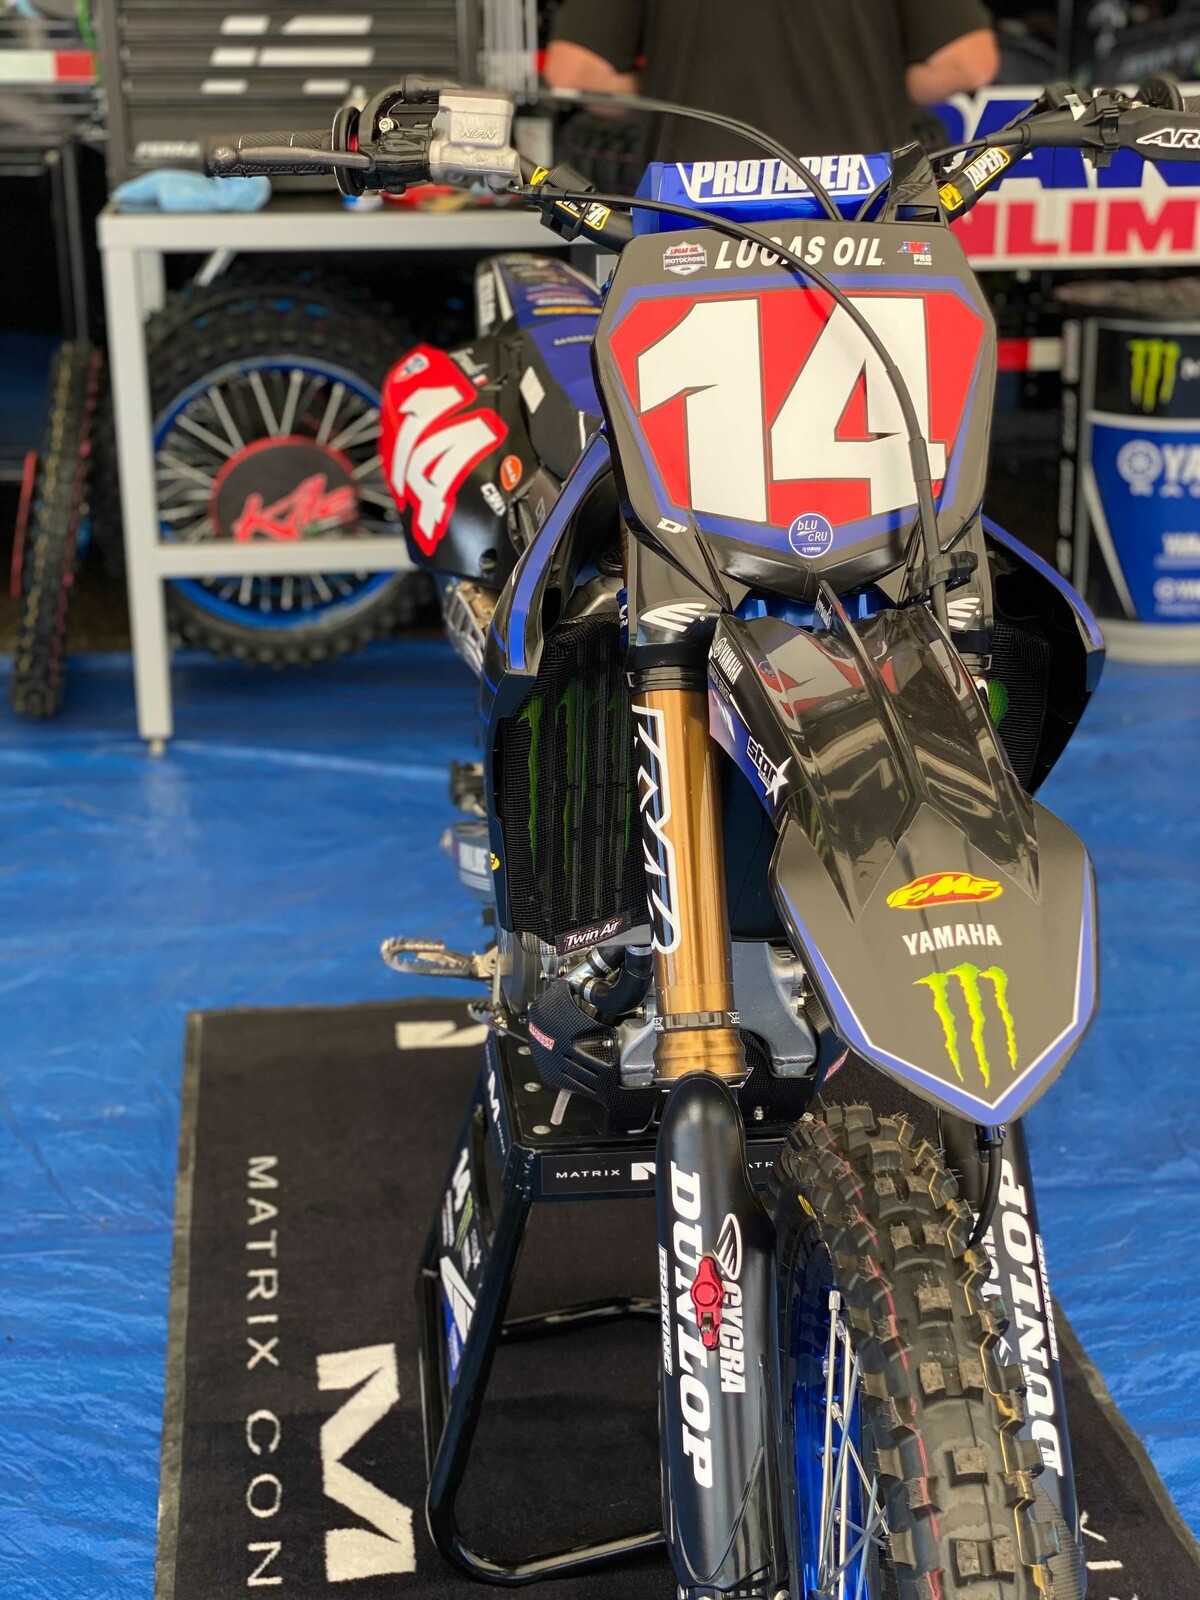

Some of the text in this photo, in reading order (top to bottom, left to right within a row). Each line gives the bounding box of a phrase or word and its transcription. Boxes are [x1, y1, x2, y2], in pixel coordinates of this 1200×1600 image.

[1136, 128, 1200, 148] AR
[688, 153, 866, 203] PROTAPER
[666, 255, 706, 265] MOTOCROSS
[714, 236, 825, 270] LUCAS
[913, 254, 932, 262] PRO
[636, 297, 948, 523] 14
[391, 385, 498, 541] 14
[717, 647, 743, 685] YAMAHA
[888, 876, 1000, 908] FMF
[566, 929, 599, 948] Twin
[600, 919, 621, 938] Air
[901, 923, 1003, 956] YAMAHA
[555, 1169, 621, 1179] MATRIX
[670, 1160, 713, 1489] DUNLOP
[999, 1158, 1064, 1477] DUNLOP
[720, 1280, 746, 1393] CYCRA
[246, 1155, 283, 1588] MATRIX CON
